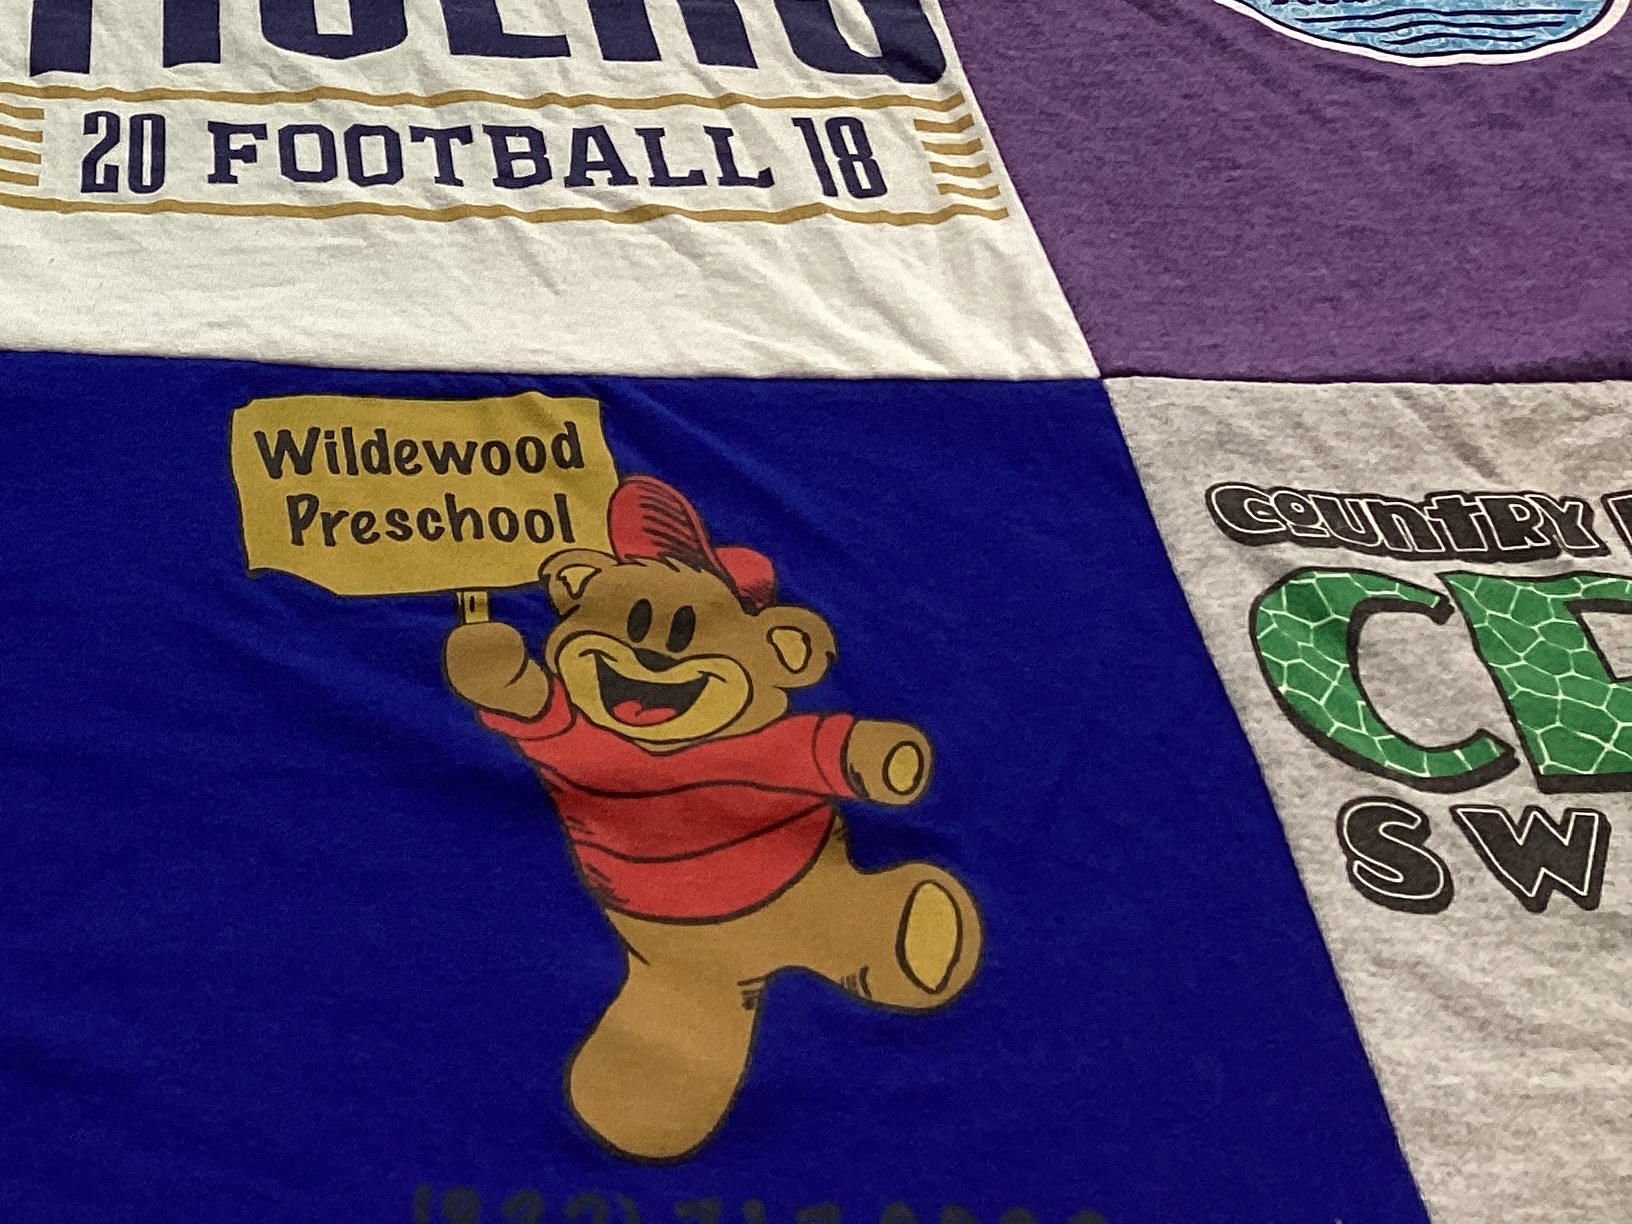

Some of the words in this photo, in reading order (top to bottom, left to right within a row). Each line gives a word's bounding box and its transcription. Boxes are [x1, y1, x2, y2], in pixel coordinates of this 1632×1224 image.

[80, 110, 167, 196] 20
[206, 119, 776, 191] FOOTBALL
[791, 116, 889, 200] 18
[254, 421, 586, 480] Wildewood
[285, 492, 577, 548] Preschool
